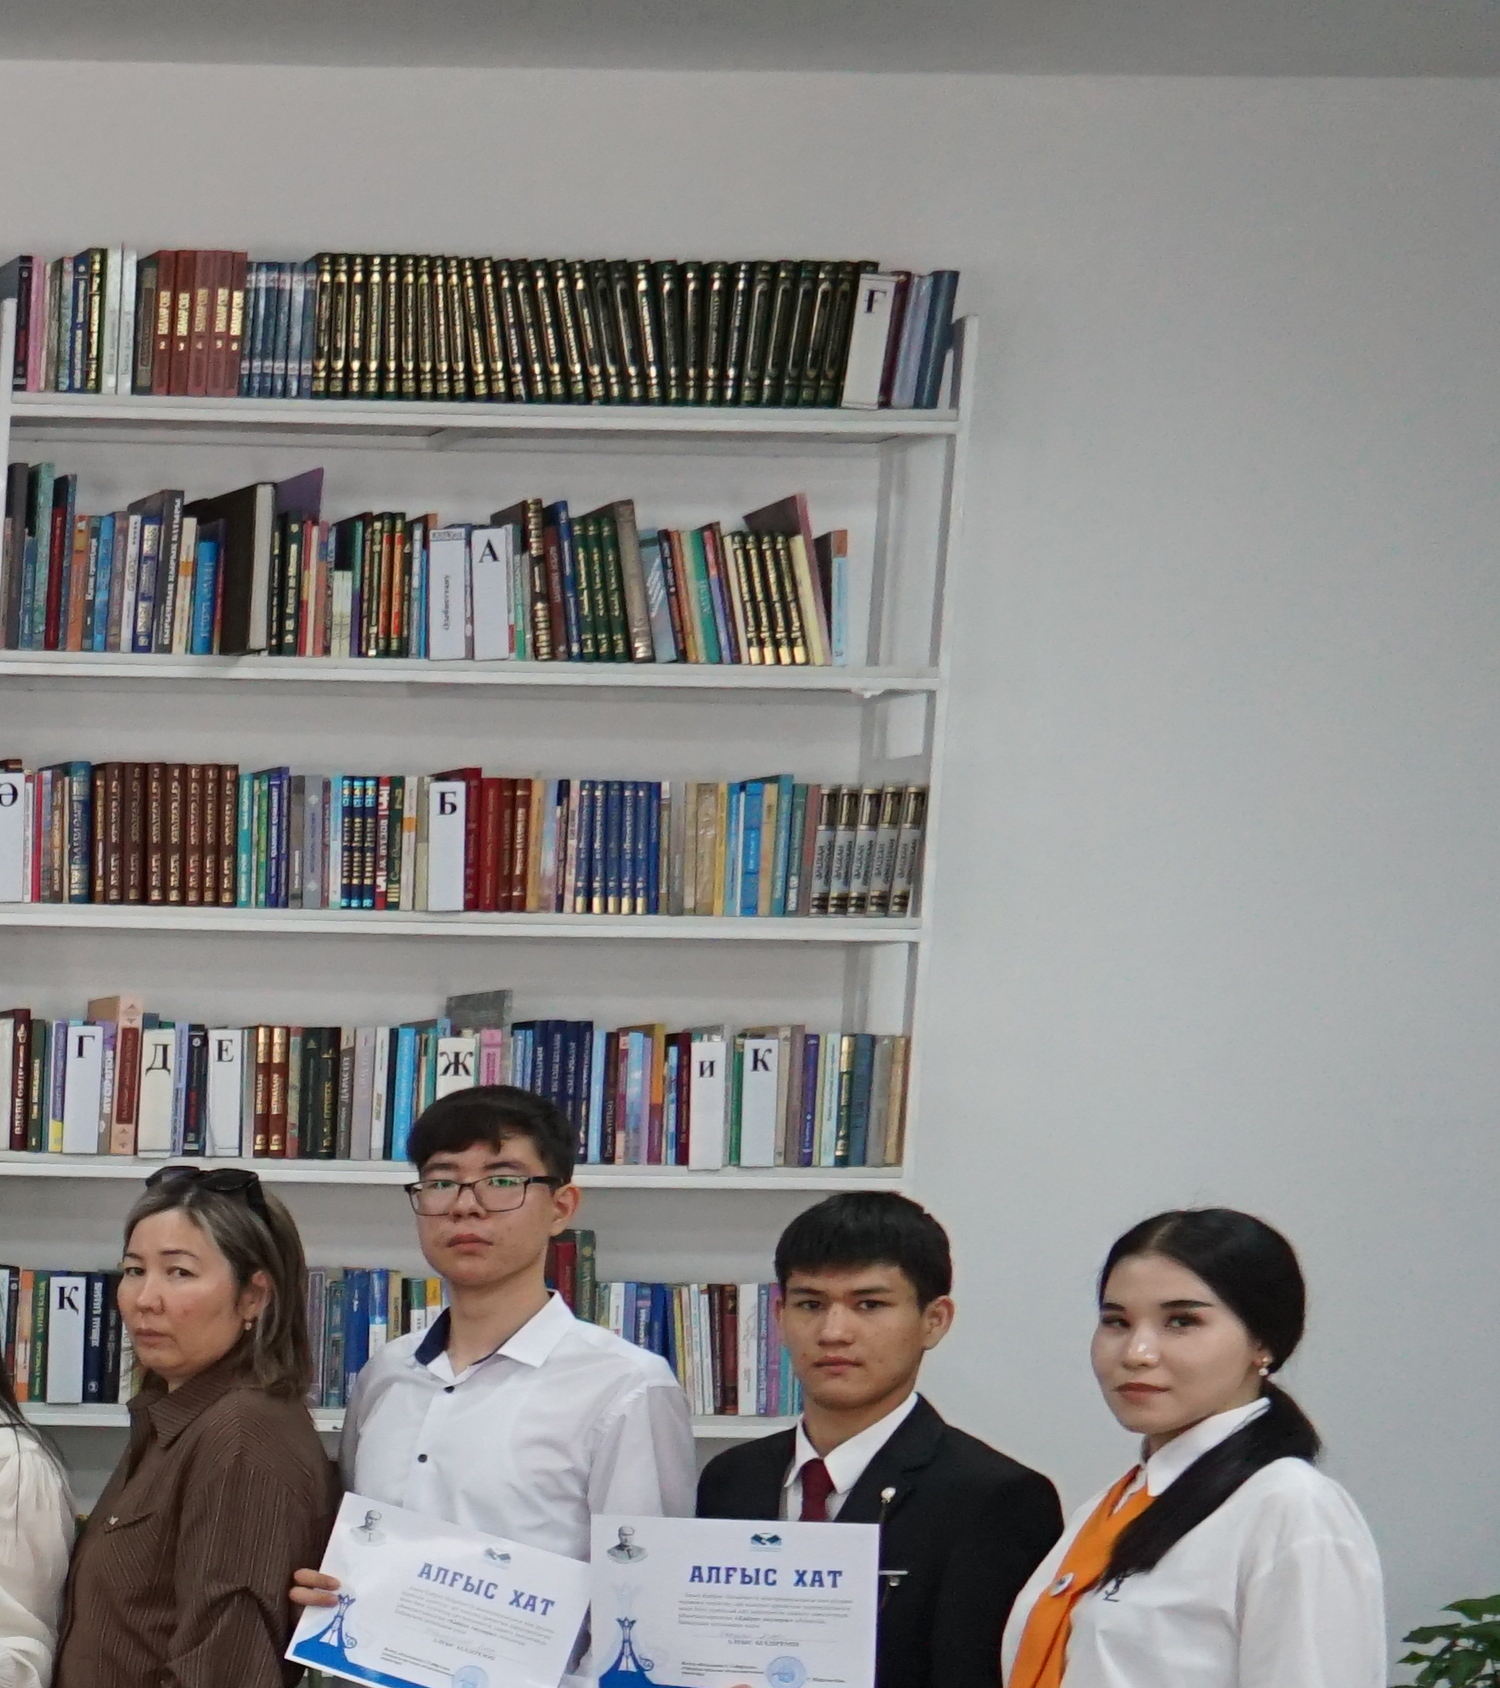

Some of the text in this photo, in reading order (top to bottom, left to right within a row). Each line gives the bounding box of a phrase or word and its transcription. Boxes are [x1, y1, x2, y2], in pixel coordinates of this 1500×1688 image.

[417, 1563, 499, 1600] АЛҒЫС
[508, 1589, 556, 1617] ХАТ
[689, 1565, 844, 1589] АЛҒЫС ХАТ
